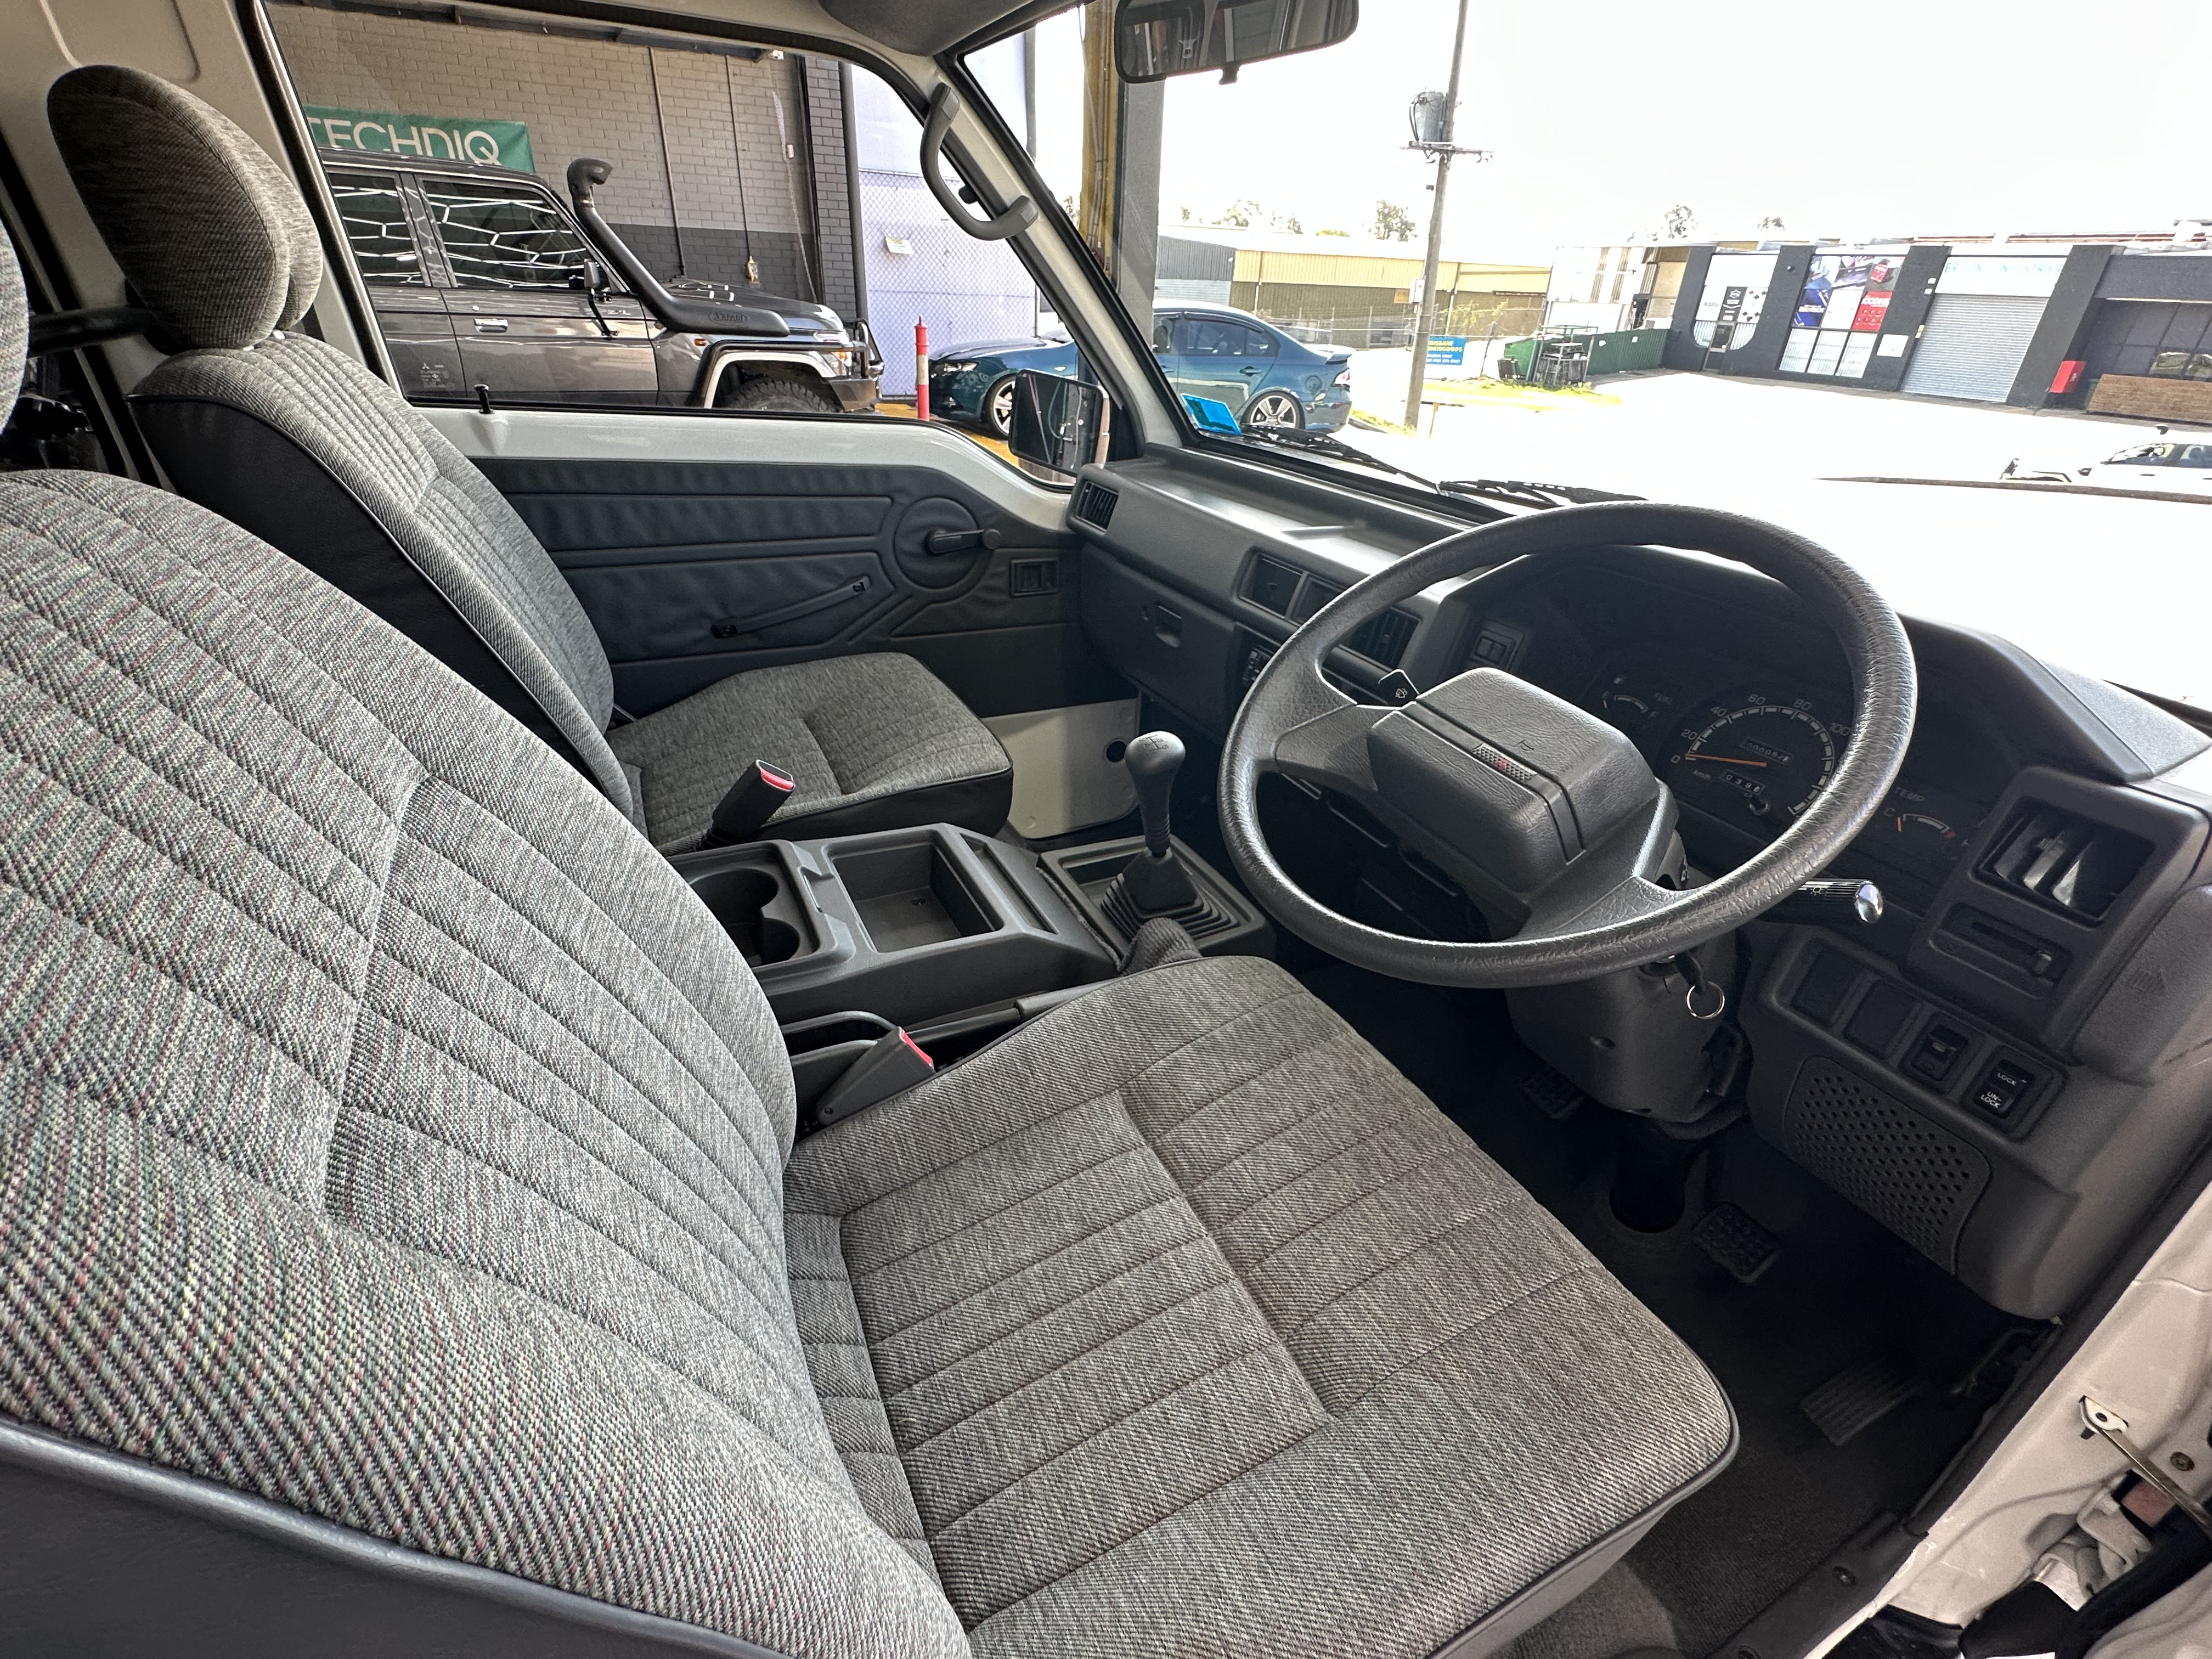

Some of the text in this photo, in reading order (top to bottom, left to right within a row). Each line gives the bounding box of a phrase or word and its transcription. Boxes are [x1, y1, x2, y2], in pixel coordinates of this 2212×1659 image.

[1748, 694, 1765, 704] 60
[1793, 699, 1812, 710] 80
[1712, 706, 1727, 716] 40
[1681, 729, 1697, 740] 20
[1831, 722, 1851, 736] 100
[1671, 754, 1681, 763] 0
[1997, 1073, 2017, 1086] LOCK
[1980, 1094, 2001, 1108] LOCK
[1987, 1091, 2002, 1102] UN-
